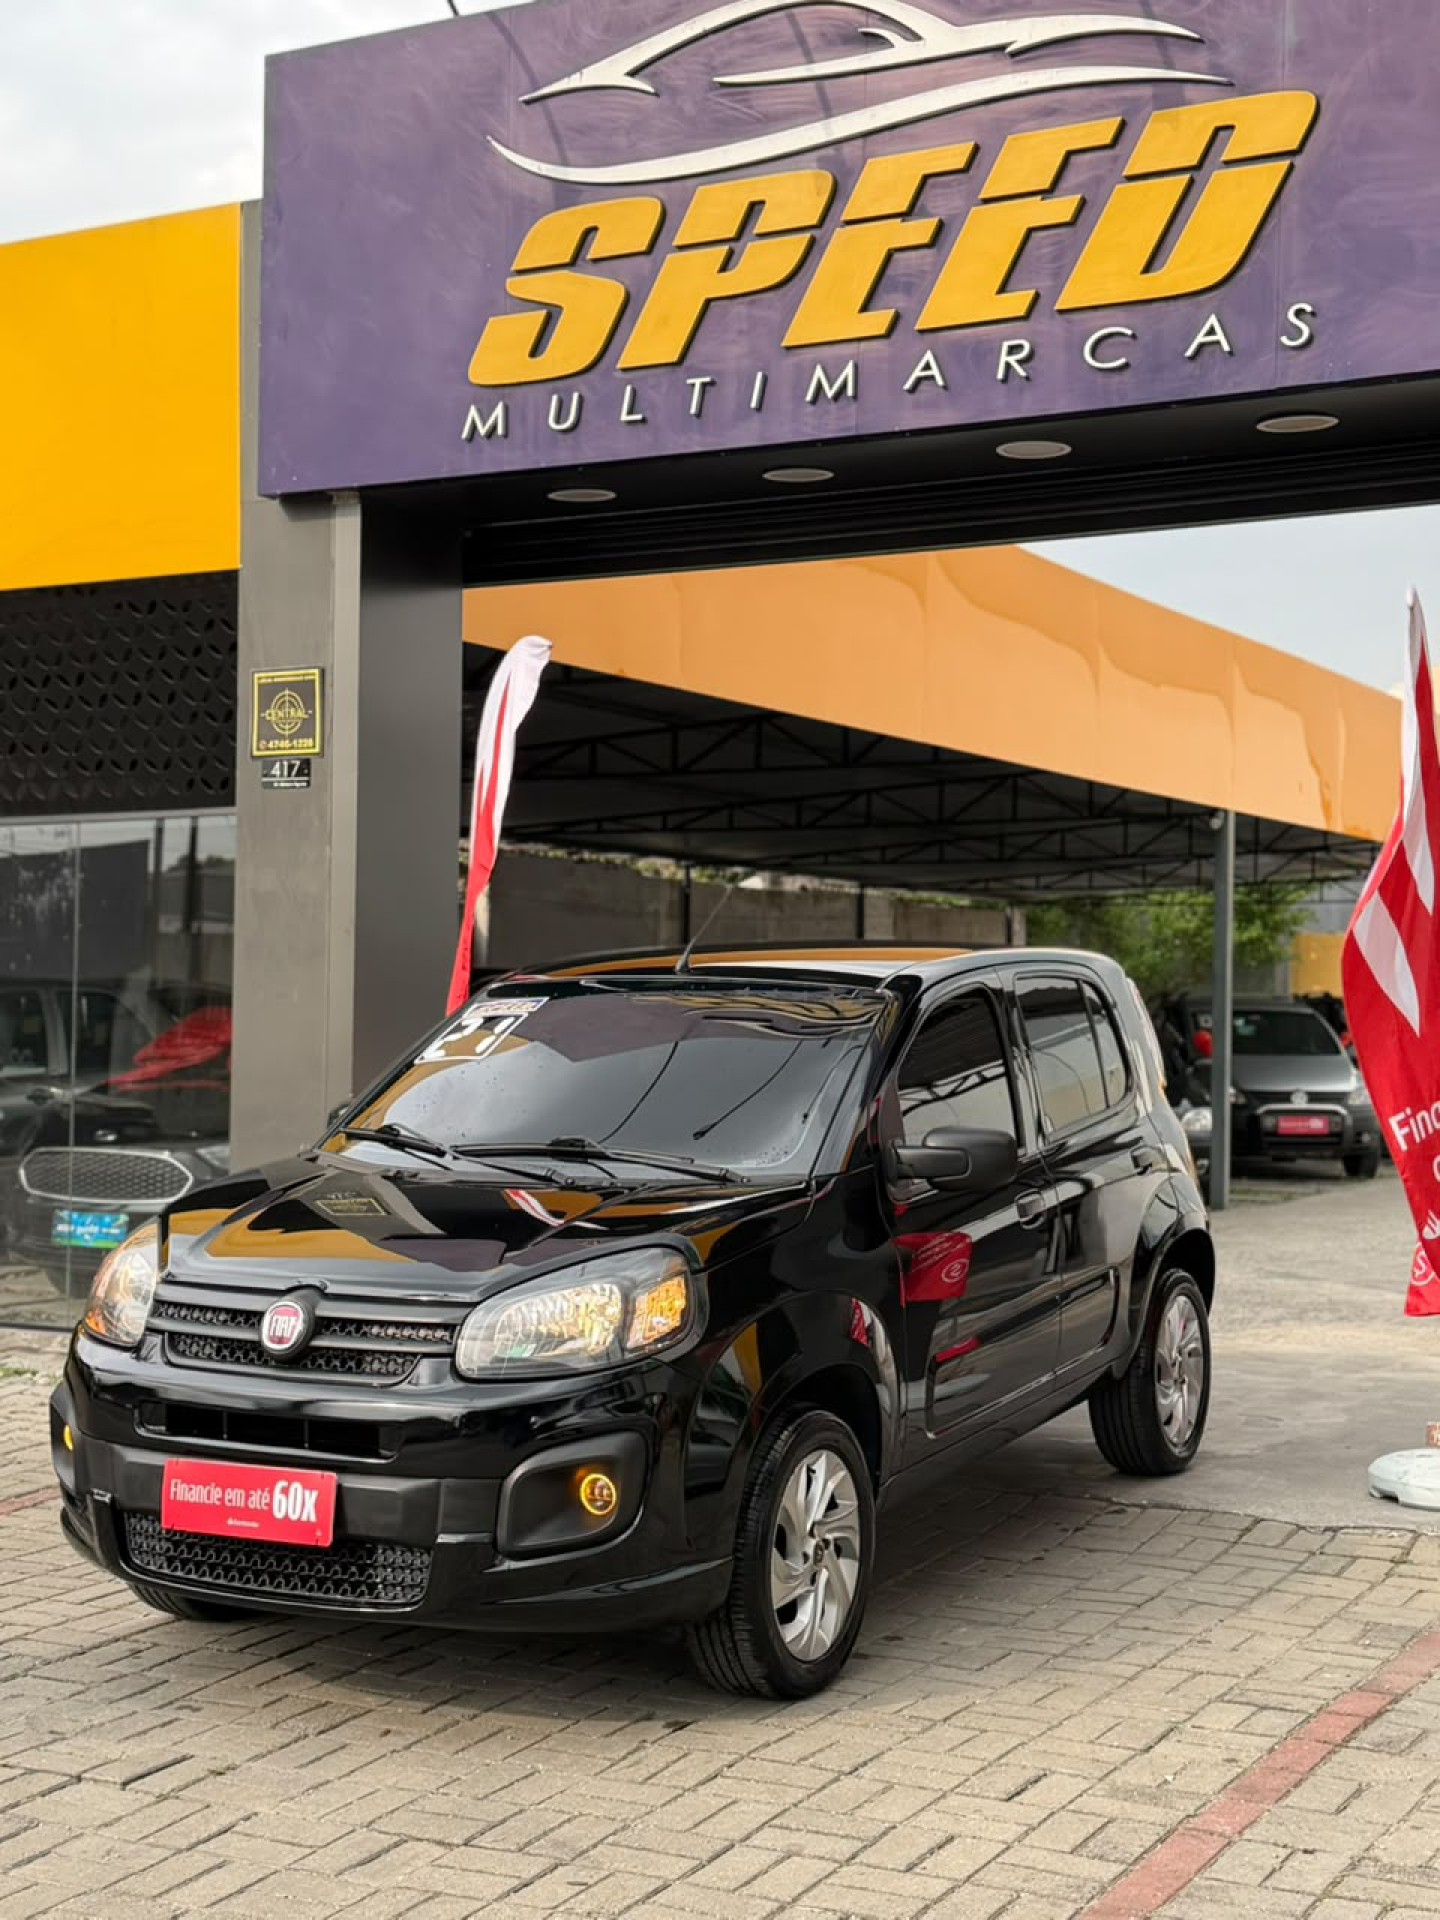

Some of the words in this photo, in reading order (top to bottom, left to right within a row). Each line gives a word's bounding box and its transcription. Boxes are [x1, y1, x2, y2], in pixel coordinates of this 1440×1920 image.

[467, 89, 1319, 386] SPEED
[461, 301, 1314, 442] MULTIMARCAS
[271, 761, 301, 778] 417
[271, 1315, 298, 1337] FIAT
[170, 1479, 223, 1505] Financie
[224, 1488, 246, 1508] em
[247, 1486, 271, 1510] até
[272, 1480, 320, 1523] 60x
